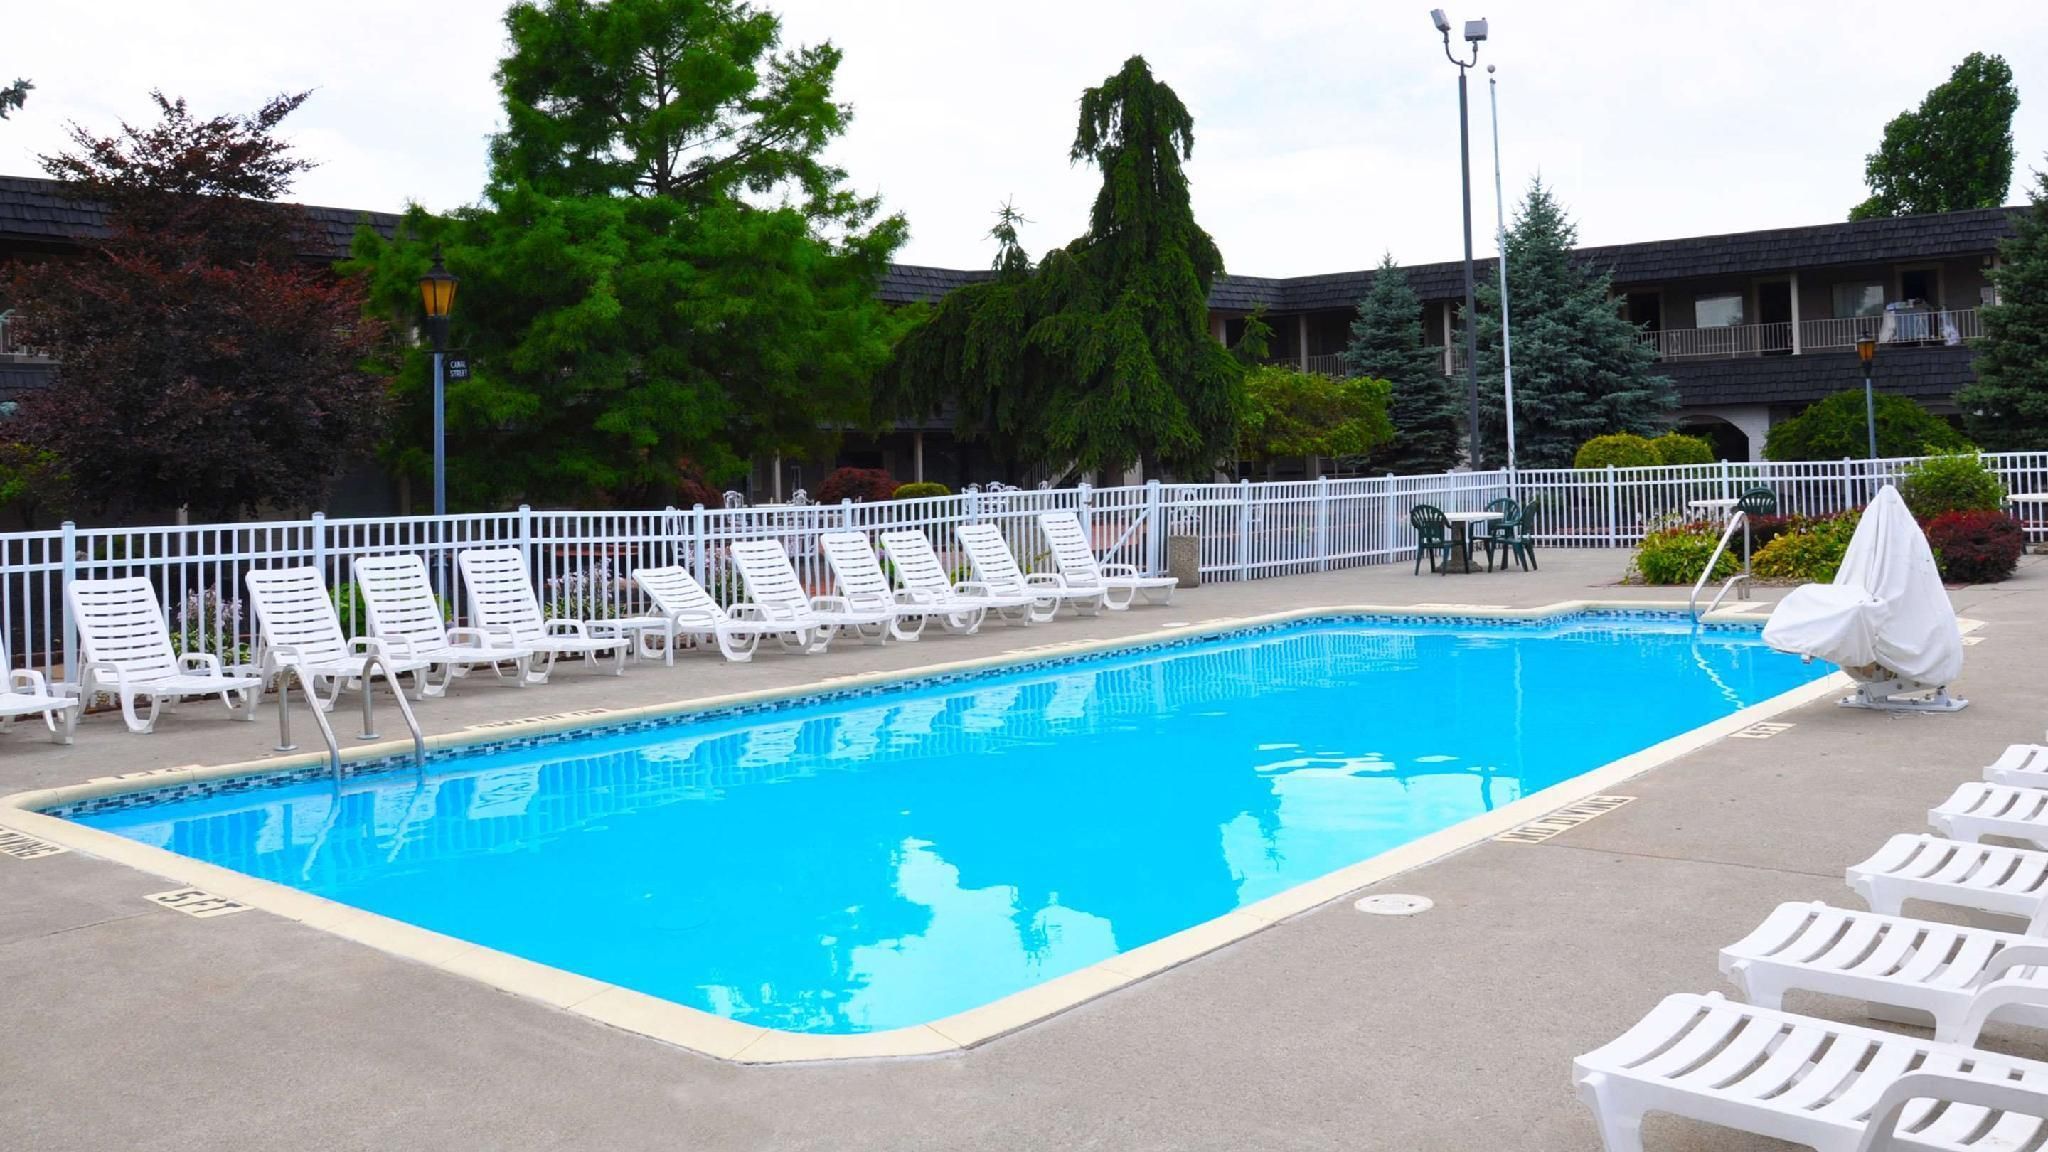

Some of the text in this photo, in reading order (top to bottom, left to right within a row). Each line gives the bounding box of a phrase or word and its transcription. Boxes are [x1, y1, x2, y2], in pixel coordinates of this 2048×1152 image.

[450, 369, 467, 377] STREET
[1501, 797, 1632, 842] NO DIVING
[157, 891, 242, 914] 5 FT
